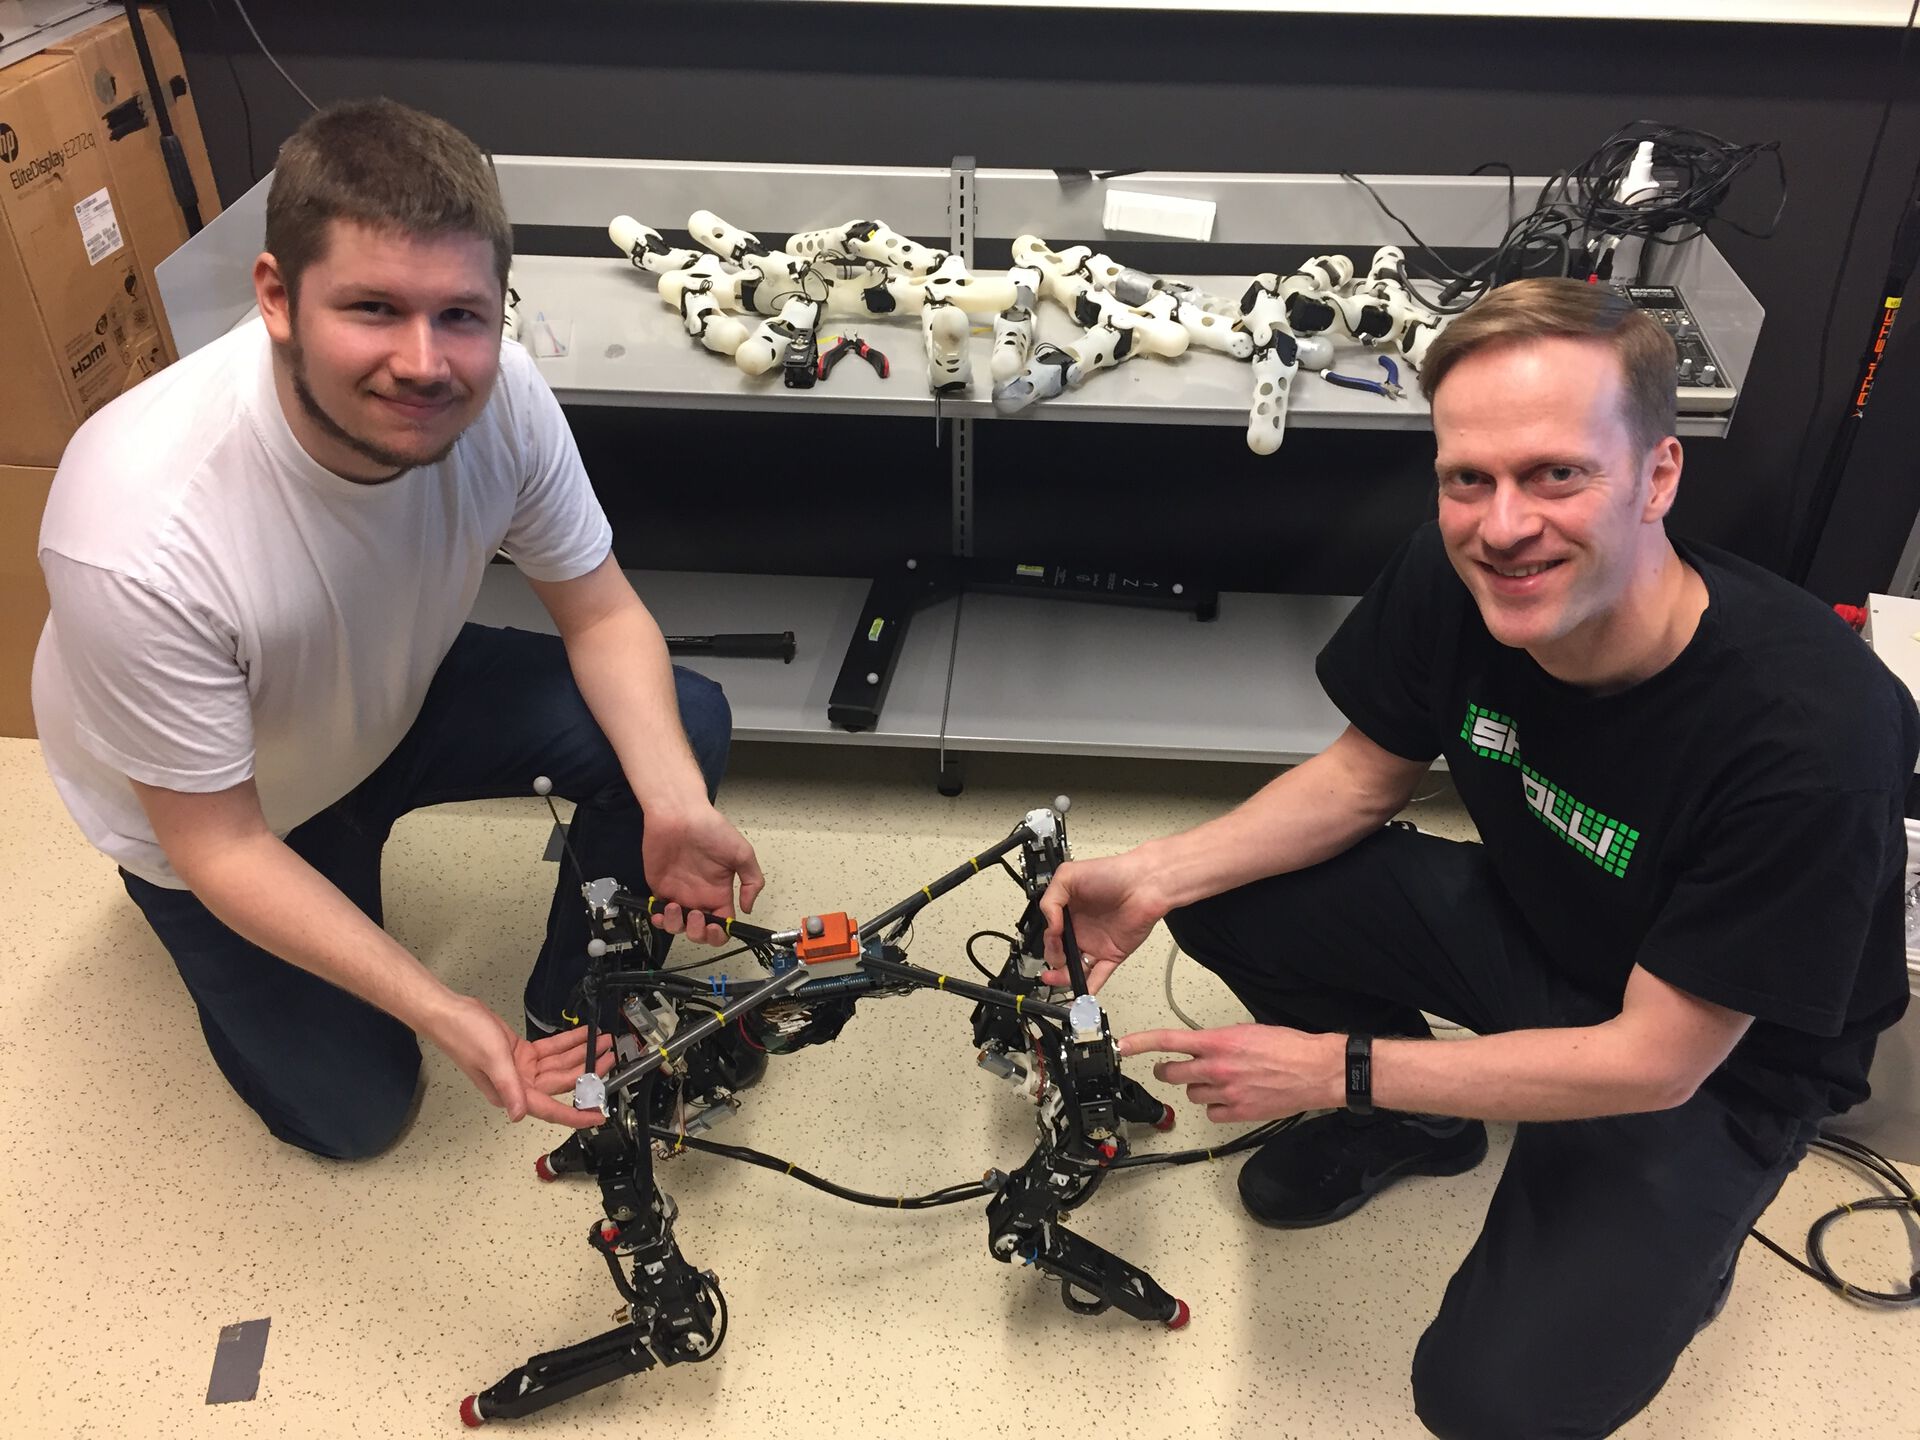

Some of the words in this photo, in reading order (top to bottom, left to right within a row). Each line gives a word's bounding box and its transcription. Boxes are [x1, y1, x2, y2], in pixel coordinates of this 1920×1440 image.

[9, 149, 65, 190] EliteDisplay
[63, 132, 96, 160] E272q
[71, 341, 108, 380] HDMI
[1856, 308, 1899, 406] ATHLETIC
